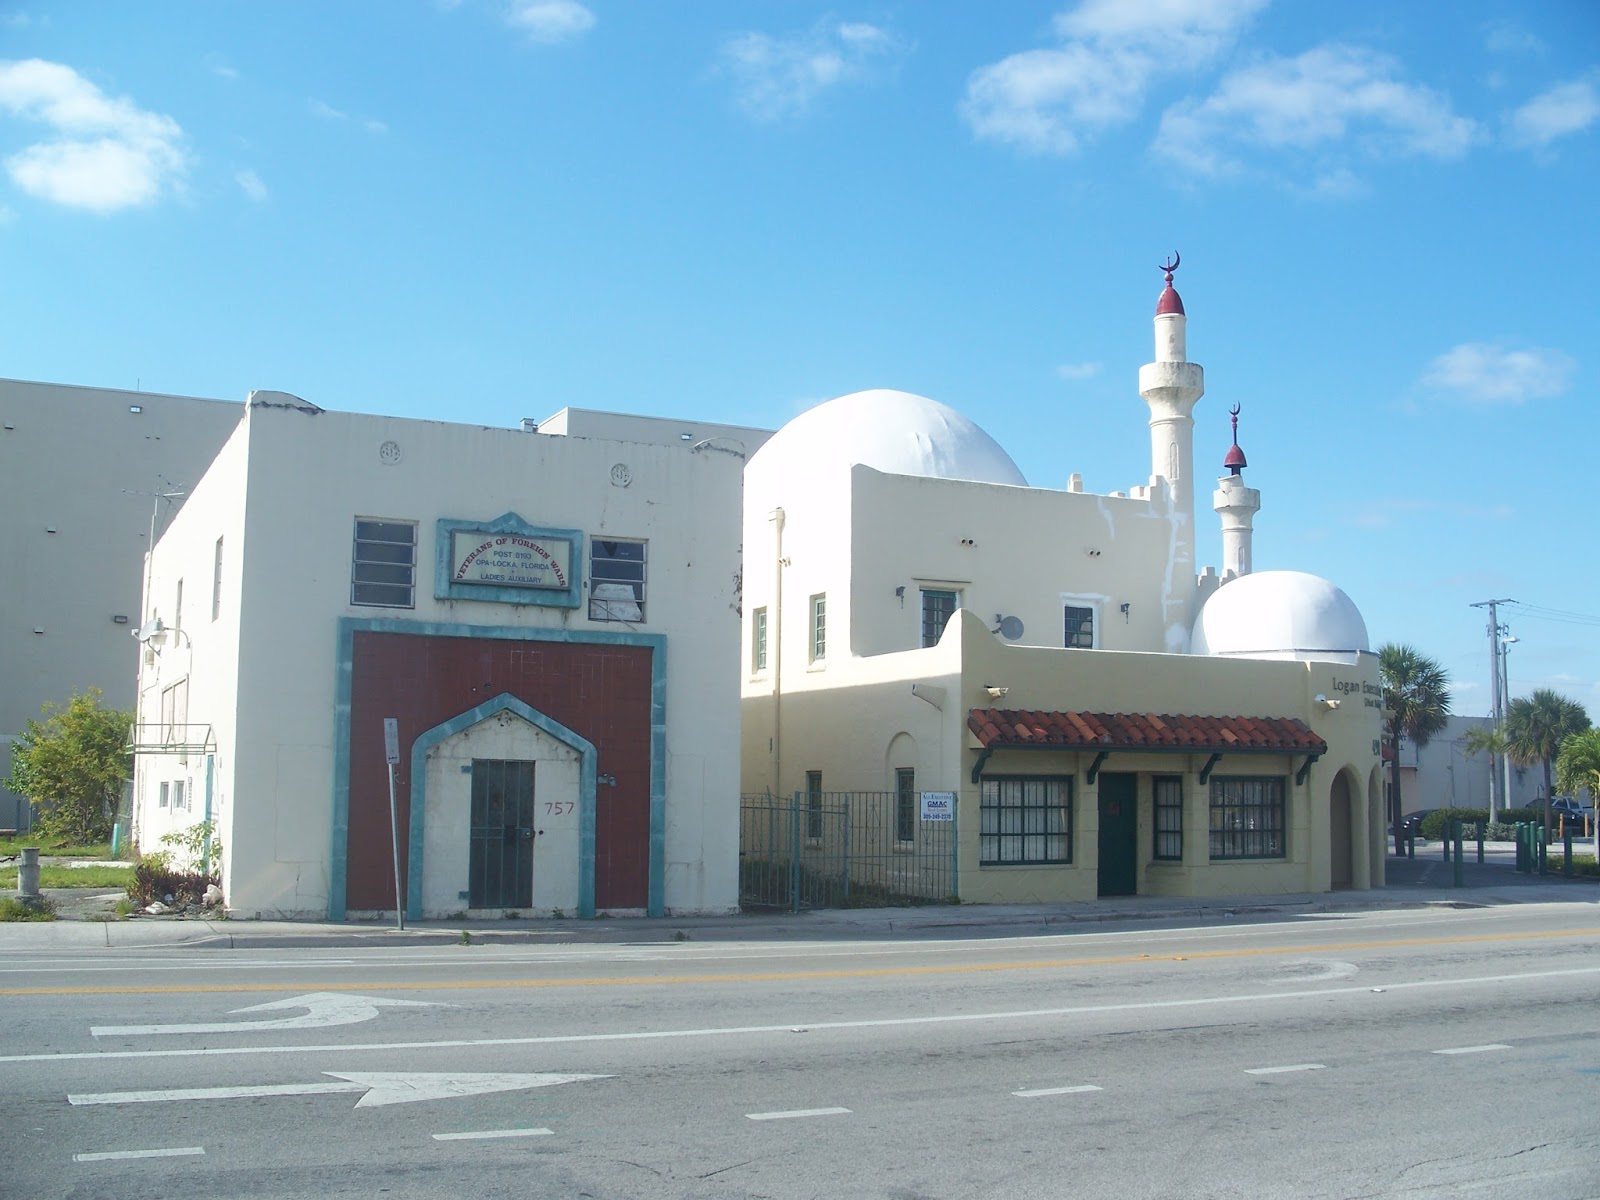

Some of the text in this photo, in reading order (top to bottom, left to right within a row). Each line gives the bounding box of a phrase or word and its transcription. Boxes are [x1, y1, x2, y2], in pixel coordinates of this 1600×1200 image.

[456, 541, 493, 580] VETERANS
[512, 538, 550, 559] FOREIGN
[550, 560, 567, 588] WARS
[515, 552, 532, 560] 8193
[508, 575, 543, 584] AUXILIARY
[1332, 677, 1360, 696] Logan
[544, 801, 575, 816] 757
